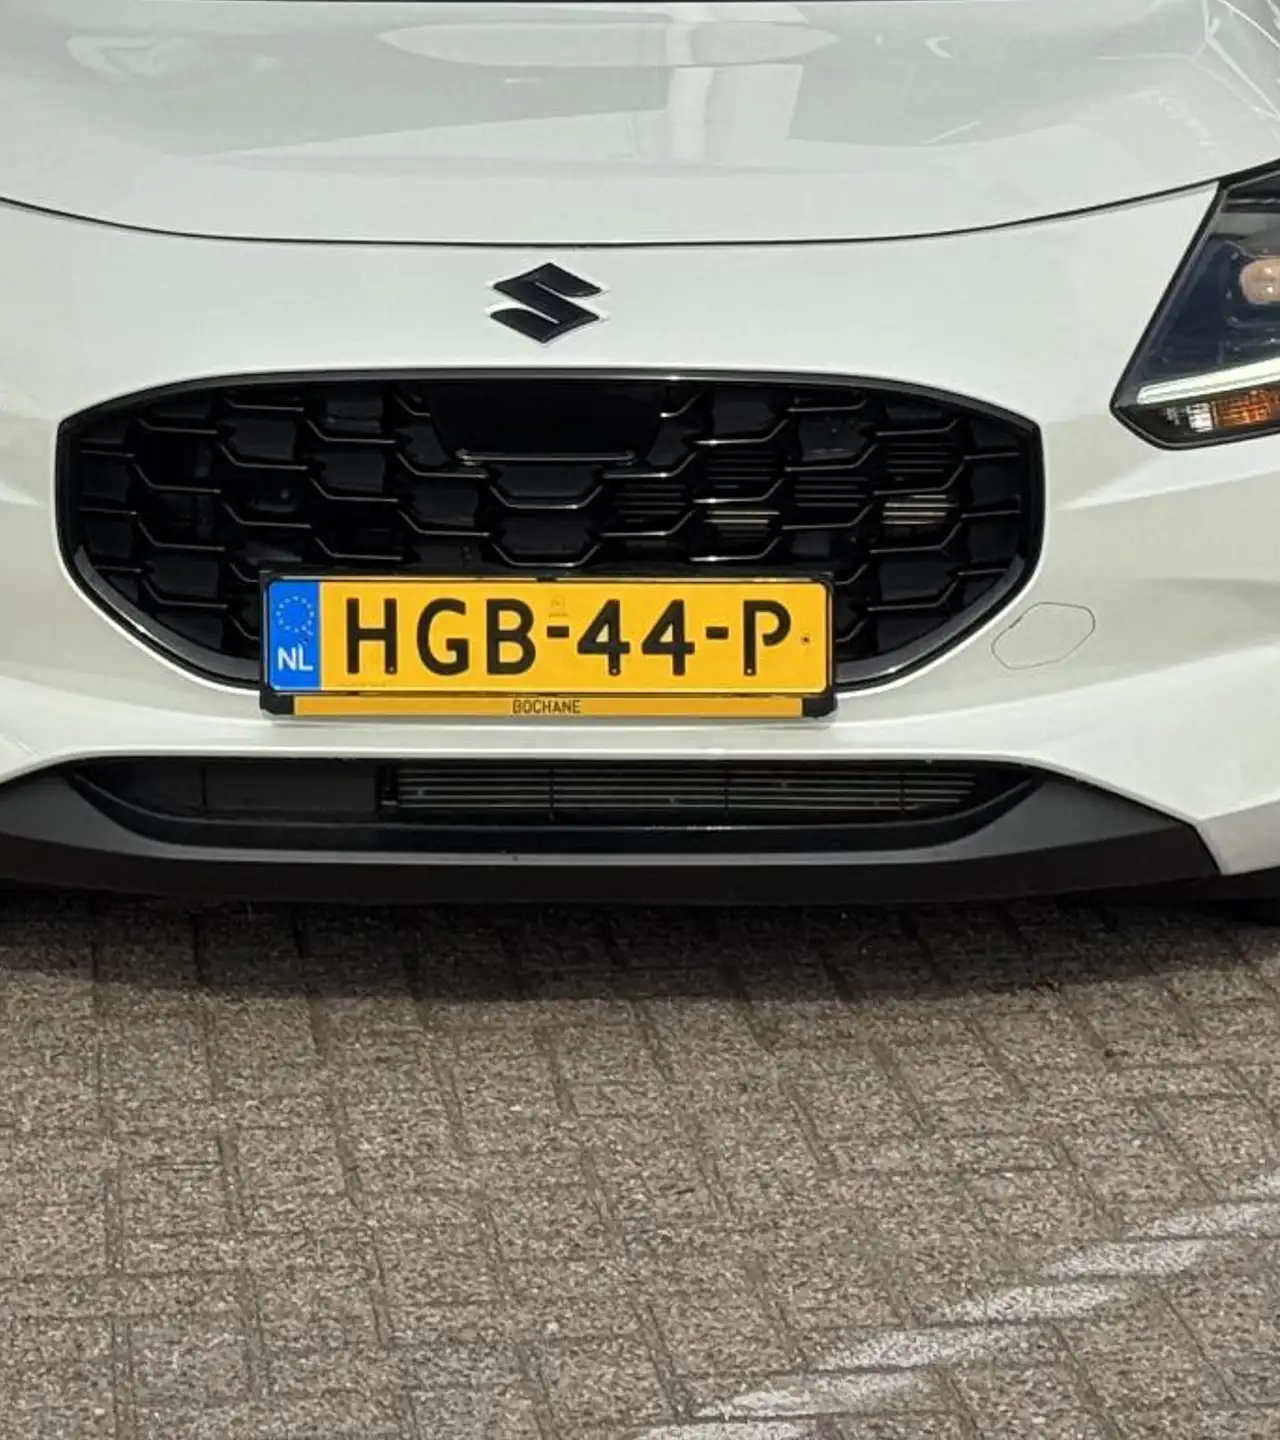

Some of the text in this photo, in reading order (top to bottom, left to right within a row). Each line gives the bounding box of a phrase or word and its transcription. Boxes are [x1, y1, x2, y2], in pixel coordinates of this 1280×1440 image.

[277, 597, 793, 678] NL HGB-44-P
[511, 698, 583, 715] BOCHANE
